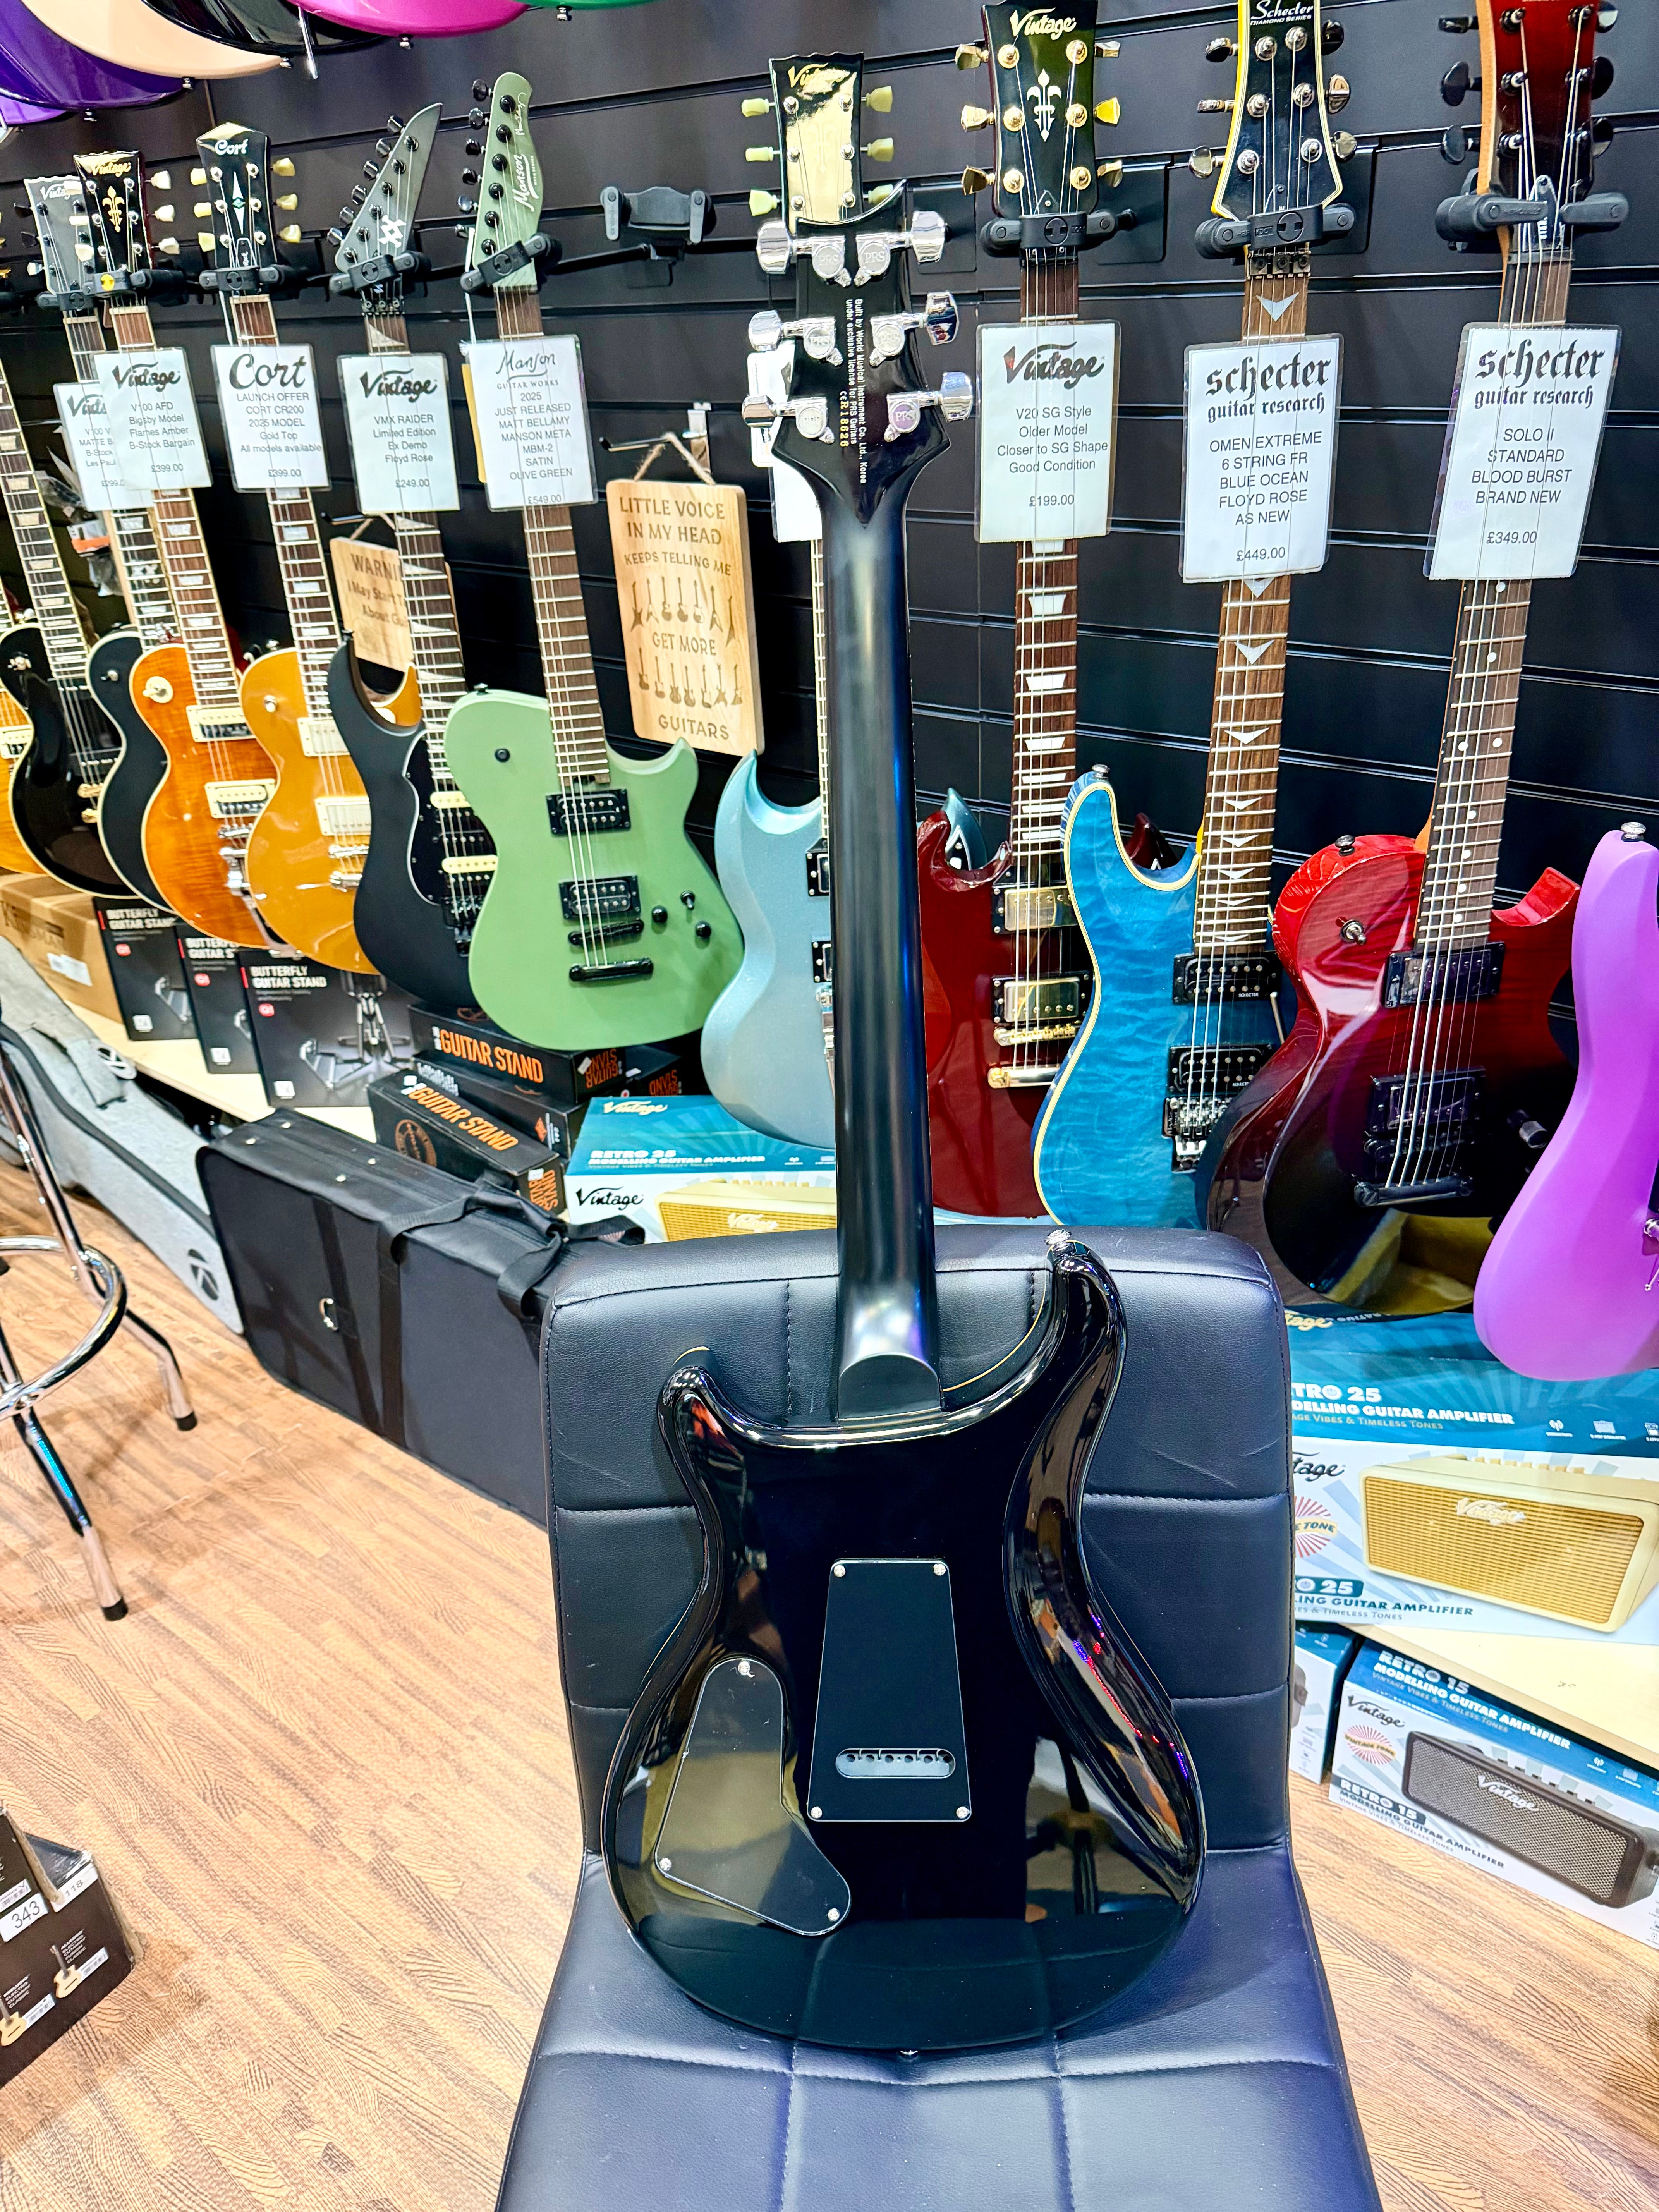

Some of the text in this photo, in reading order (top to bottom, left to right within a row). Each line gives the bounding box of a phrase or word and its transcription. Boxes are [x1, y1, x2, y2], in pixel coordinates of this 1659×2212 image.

[1010, 8, 1077, 40] Vintage
[215, 139, 248, 155] Cort
[90, 160, 131, 177] Vintage
[864, 251, 885, 263] PRS
[855, 319, 864, 328] by
[856, 330, 864, 352] World
[846, 299, 857, 416] under license for PRS
[1475, 338, 1606, 388] schecter
[229, 353, 307, 390] Cort
[857, 354, 865, 383] Musical
[1003, 341, 1104, 390] Vintage
[112, 362, 181, 392] Vintage
[1206, 352, 1332, 400] schecter
[360, 368, 438, 403] Vintage
[497, 379, 559, 390] GUITAR WORKS
[237, 392, 310, 402] LAUNCH OFFER
[520, 392, 542, 402] 2025
[1474, 385, 1594, 410] guitar research
[155, 402, 173, 410] AFD
[246, 405, 304, 414] CORT CR200
[495, 403, 572, 416] JUST RELEASED
[1016, 405, 1092, 420] V20 SG Style
[1207, 392, 1326, 423] guitar research
[129, 414, 184, 426] Bigsby Model
[249, 418, 305, 427] 2025 MODEL
[374, 414, 434, 424] VMX RAIDER
[499, 416, 570, 429] MATT BELLAMY
[130, 427, 189, 437] Flames Amber
[260, 431, 298, 440] Gold Top
[373, 428, 436, 438] Limited Edition
[501, 429, 572, 442] MANSON META
[1019, 424, 1088, 438] Older Model
[1503, 428, 1543, 441] SOLO
[164, 438, 195, 450] Bargain
[285, 443, 322, 452] available
[402, 441, 428, 450] Demo
[523, 443, 553, 453] MBM-2
[997, 441, 1108, 457] Closer to SG Shape
[1209, 431, 1322, 453] OMEN EXTREME
[385, 453, 433, 464] Floyd Rose
[526, 456, 554, 467] SATIN
[1222, 452, 1308, 471] 6 STRING FR
[1487, 448, 1565, 463] STANDARD
[151, 463, 184, 473] £399.00
[268, 469, 302, 477] £399.00
[510, 468, 573, 480] OLIVE GREEN
[1009, 459, 1096, 474] Good Condition
[395, 478, 430, 488] £249.00
[1220, 471, 1309, 490] BLUE OCEAN
[1471, 469, 1572, 484] BLOOD BURST
[528, 495, 562, 505] £549.00
[1029, 494, 1074, 507] £199.00
[1219, 489, 1308, 508] FLOYD ROSE
[1475, 489, 1562, 505] BRAND NEW
[620, 496, 725, 520] LITTLE VOICE
[1235, 510, 1290, 526] AS NEW
[627, 522, 722, 545] IN MY HEAD
[1486, 531, 1537, 544] £349.00
[1236, 547, 1286, 562] £449.00
[624, 551, 732, 576] KEEPS TELLING ME
[652, 631, 717, 657] GET MORE
[658, 714, 730, 741] GUITARS
[250, 965, 308, 977] BUTTERFLY
[252, 976, 327, 988] GUITAR STAND
[440, 1029, 493, 1068] GUITAR
[494, 1046, 543, 1084] STAND
[603, 1100, 668, 1116] Vintage
[408, 1087, 471, 1123] GUITAR
[458, 1116, 519, 1151] STAND
[591, 1150, 649, 1158] RETRO
[576, 1186, 644, 1211] Vintage
[1347, 1386, 1382, 1403] 25
[1313, 1413, 1343, 1424] VIBES
[1359, 1417, 1407, 1428] TIMELESS
[1411, 1420, 1443, 1429] TONES
[1362, 1405, 1515, 1424] GUITAR AMPLIFIER
[1304, 1522, 1335, 1533] TONE
[1321, 1580, 1354, 1595] 25
[1324, 1607, 1403, 1620] TIMELESS TONES
[1331, 1597, 1388, 1610] GUITAR
[1392, 1602, 1474, 1616] AMPLIFIER
[1379, 1650, 1470, 1695] RETRO 15
[1348, 1695, 1405, 1728] Vintage
[1373, 1662, 1571, 1750] MODELLING GUITAR AMPLIFIER
[1340, 1779, 1393, 1809] RETRO
[1477, 1775, 1540, 1812] Vintage
[1446, 1838, 1504, 1869] AMPLIFIER
[12, 1901, 40, 1929] 343
